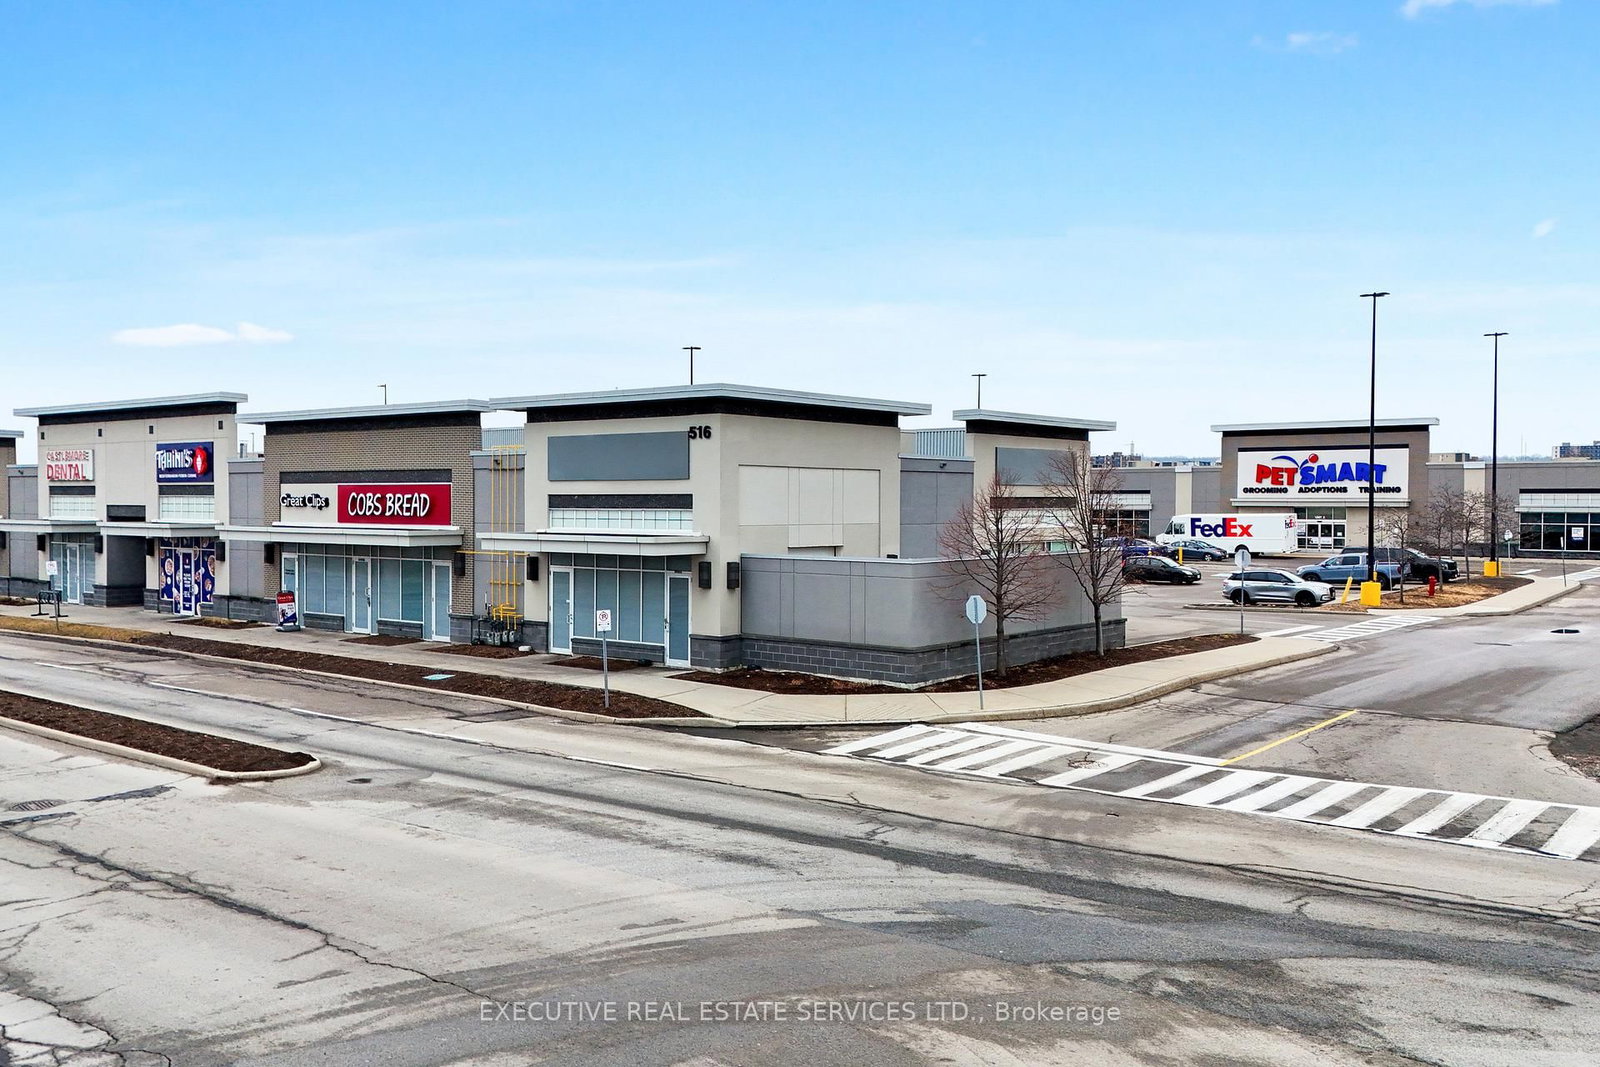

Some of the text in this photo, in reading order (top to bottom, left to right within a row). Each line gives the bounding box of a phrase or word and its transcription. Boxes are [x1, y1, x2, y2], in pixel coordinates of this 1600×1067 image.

[688, 425, 711, 440] 516
[46, 463, 86, 480] DENTAL
[1256, 462, 1387, 485] PETSMART
[1243, 486, 1288, 494] GROOMING
[1298, 486, 1348, 494] ADOPTIONS
[280, 494, 327, 509] Great Clips
[348, 492, 430, 517] COBS BREAD
[1190, 517, 1253, 538] FedEx
